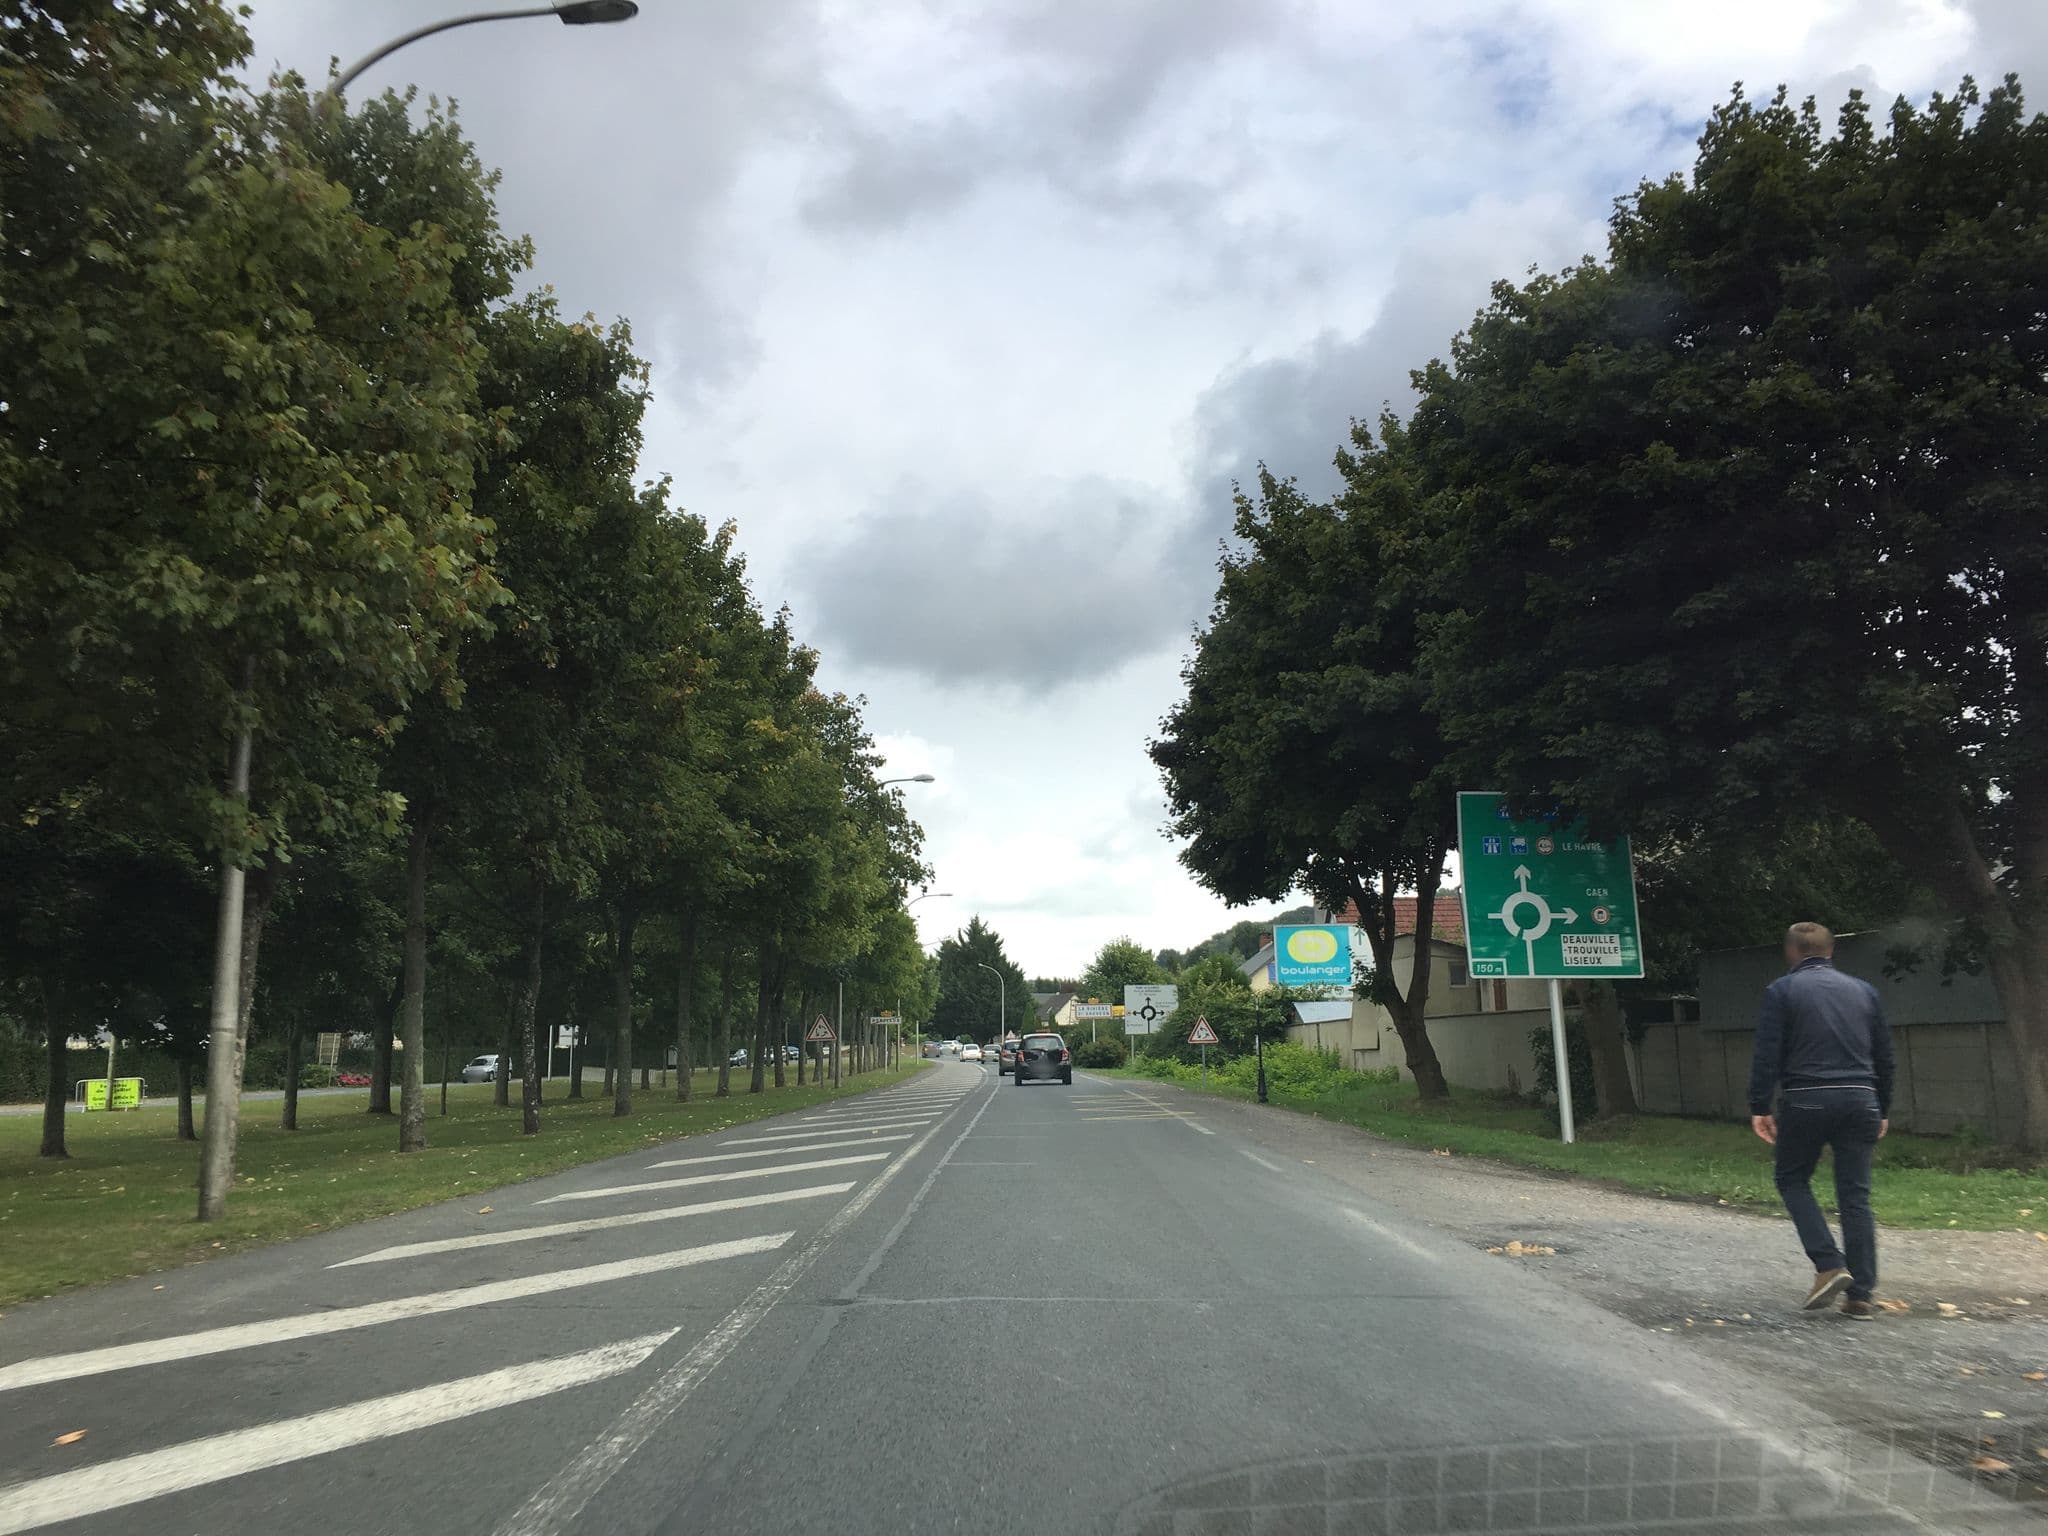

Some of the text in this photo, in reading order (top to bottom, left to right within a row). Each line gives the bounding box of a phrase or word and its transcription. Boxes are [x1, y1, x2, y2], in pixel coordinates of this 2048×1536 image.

[1562, 842, 1572, 851] LE
[1585, 888, 1609, 897] CAEN
[1562, 935, 1616, 944] DEAUVILLE
[1564, 956, 1603, 965] LISIEUX
[1280, 966, 1347, 976] boulanger
[1476, 964, 1494, 973] 150
